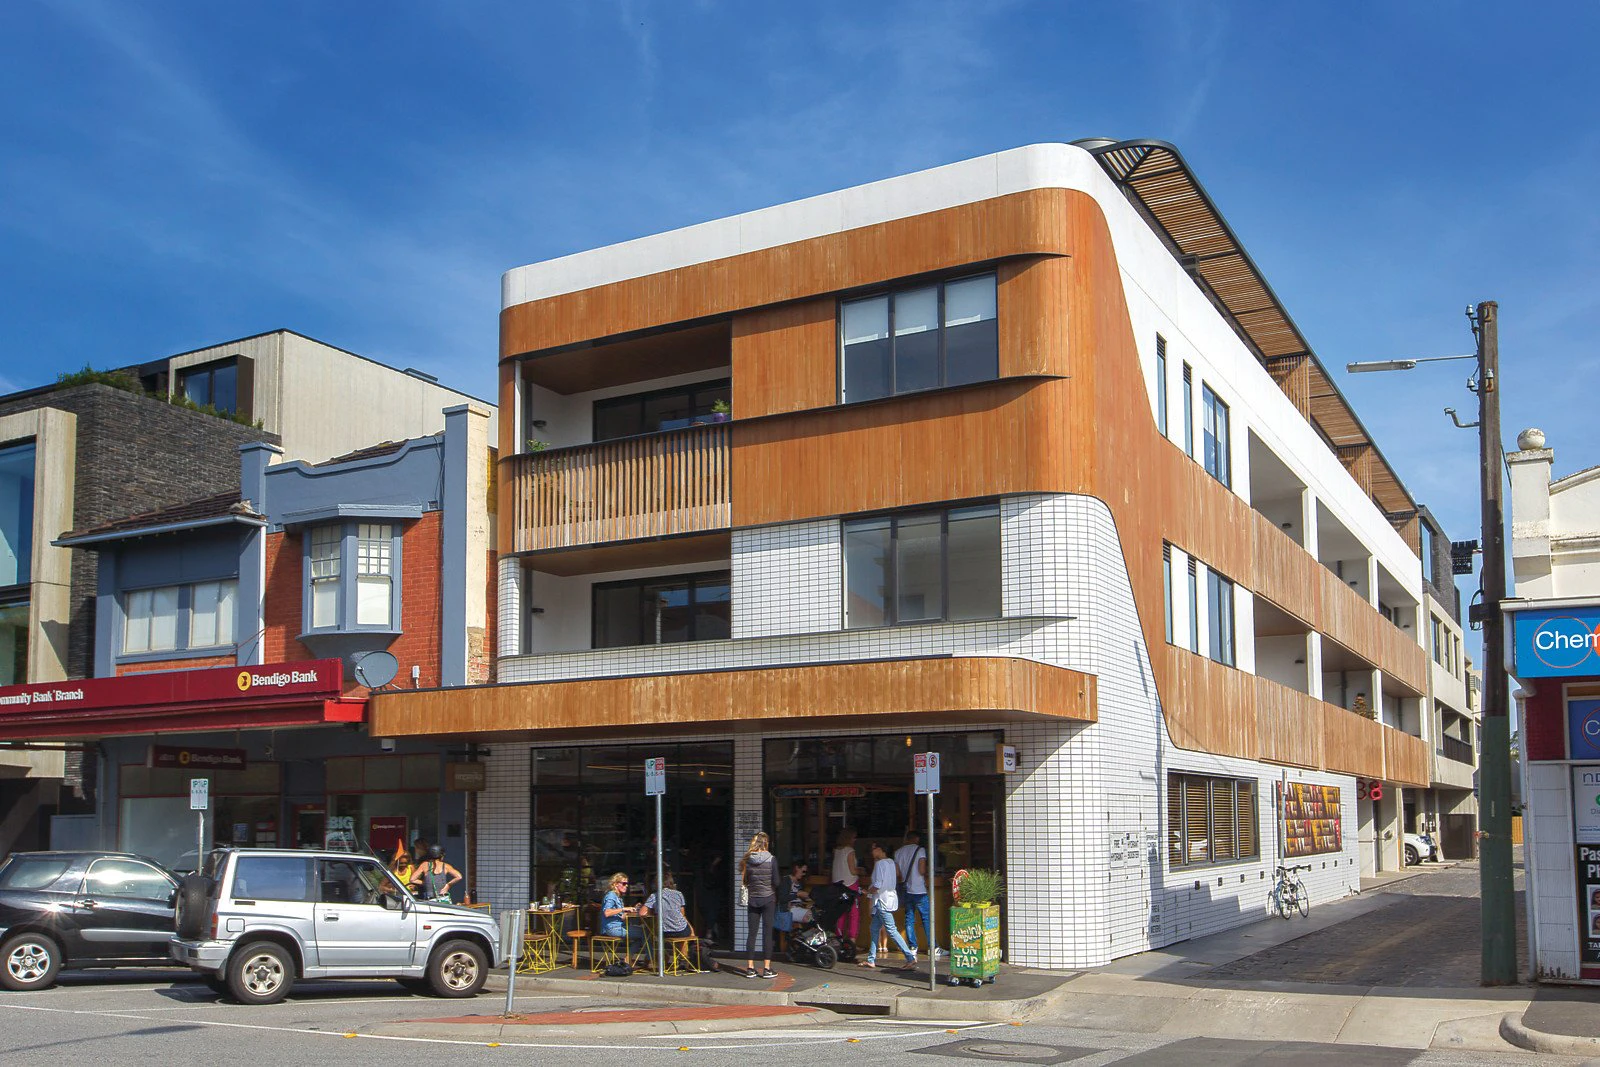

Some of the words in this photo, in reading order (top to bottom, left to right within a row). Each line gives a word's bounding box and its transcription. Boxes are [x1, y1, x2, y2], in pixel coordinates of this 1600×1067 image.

[252, 673, 291, 687] Bendigo
[292, 670, 318, 683] Bank
[33, 691, 53, 703] Bank
[55, 689, 83, 701] Branch
[961, 946, 977, 955] ON
[954, 954, 978, 968] TAP
